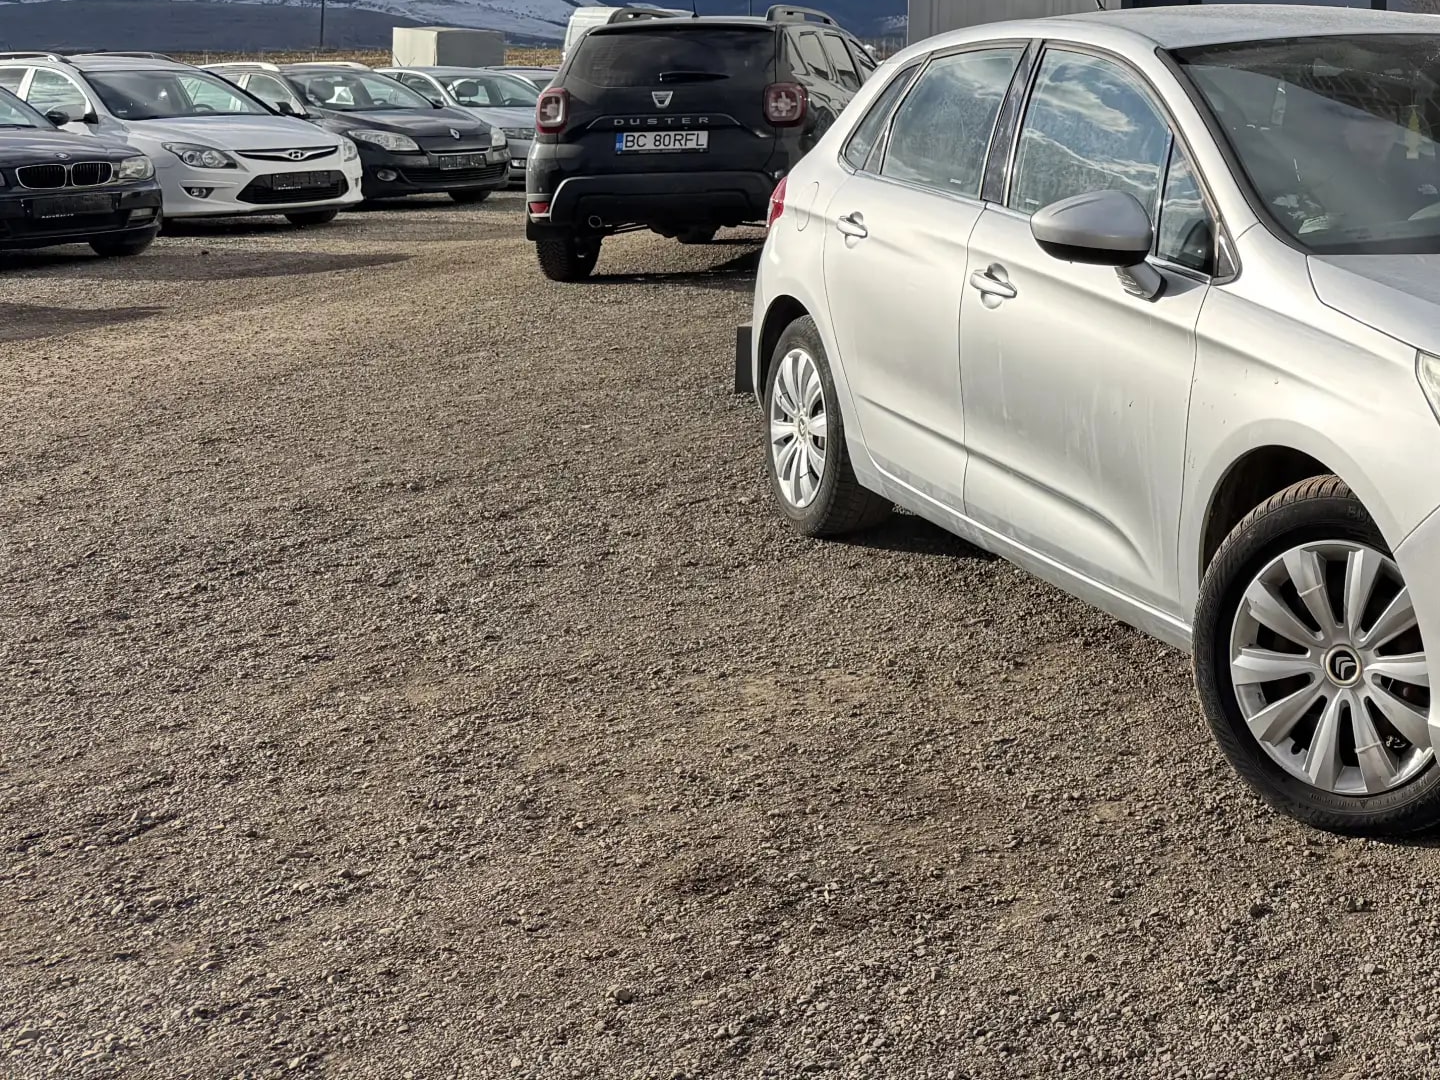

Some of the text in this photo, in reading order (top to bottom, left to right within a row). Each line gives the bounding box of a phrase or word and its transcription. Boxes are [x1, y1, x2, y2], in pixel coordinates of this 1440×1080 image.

[613, 117, 709, 126] DUSTER
[624, 132, 705, 148] BC 80RFL
